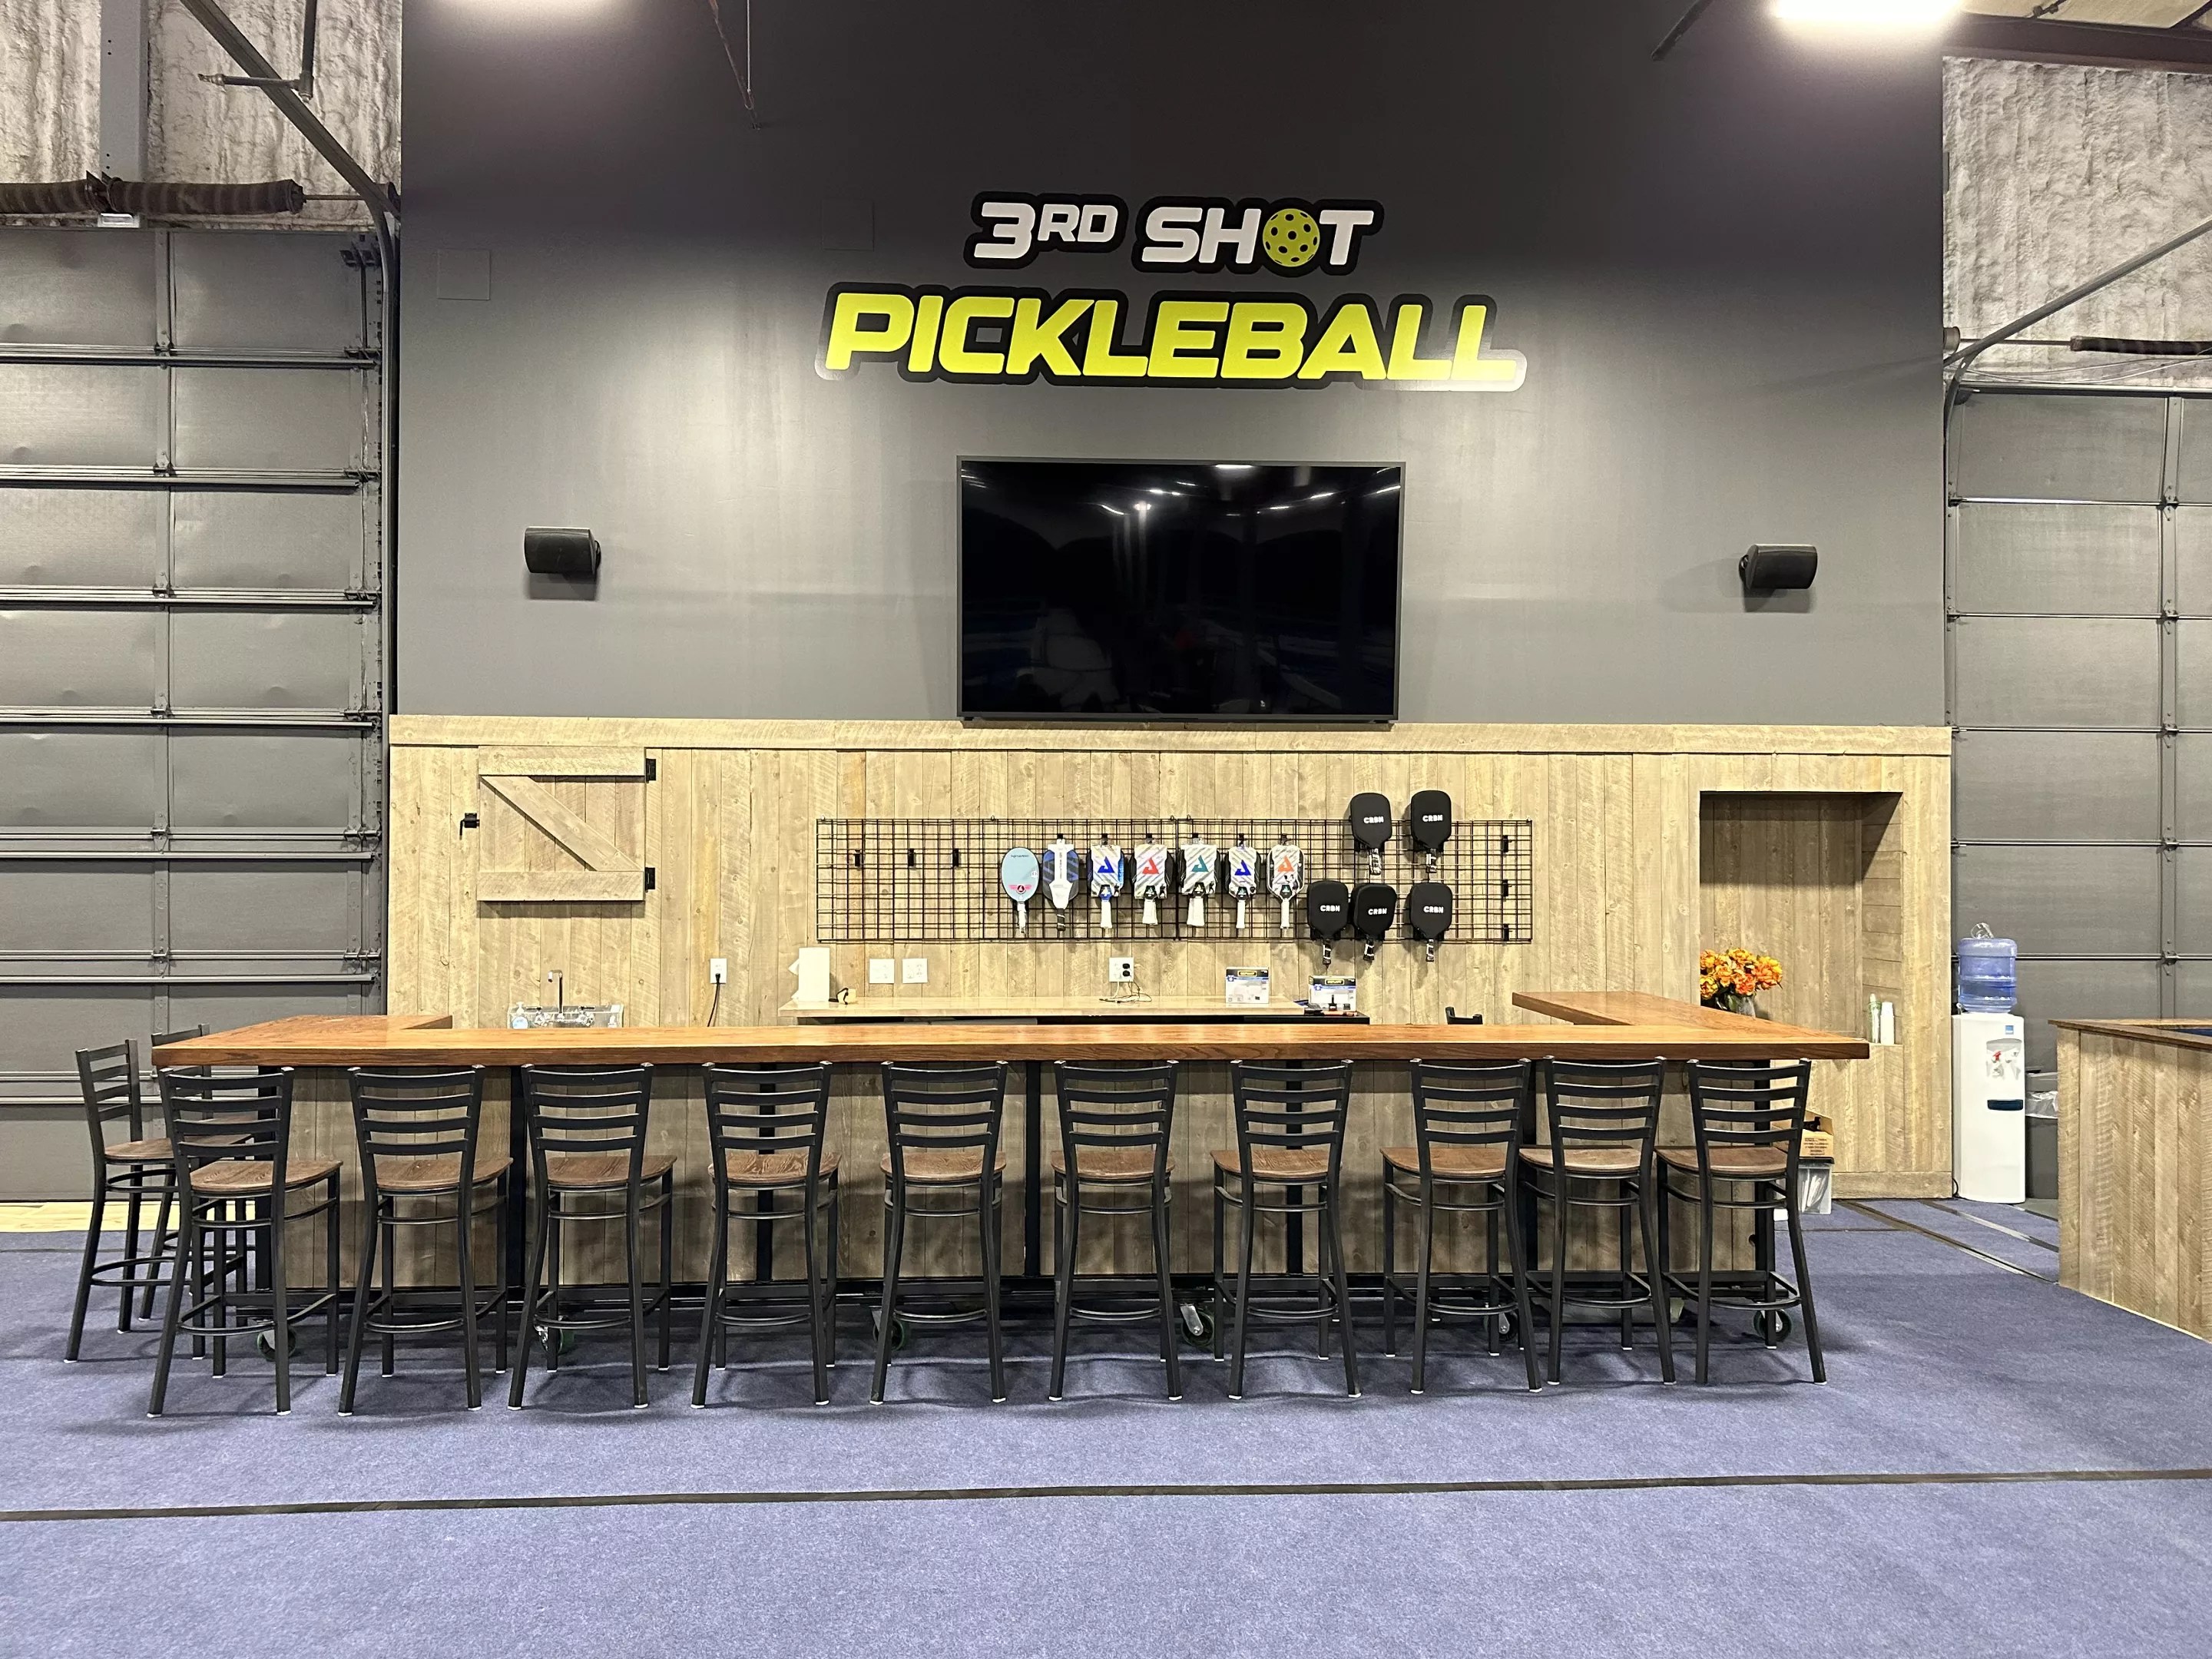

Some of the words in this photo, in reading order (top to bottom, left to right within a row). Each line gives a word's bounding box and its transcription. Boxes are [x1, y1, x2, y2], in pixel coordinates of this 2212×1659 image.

[973, 201, 1118, 259] 3RD
[1141, 207, 1375, 268] SHOT
[825, 292, 1517, 381] PICKLEBALL
